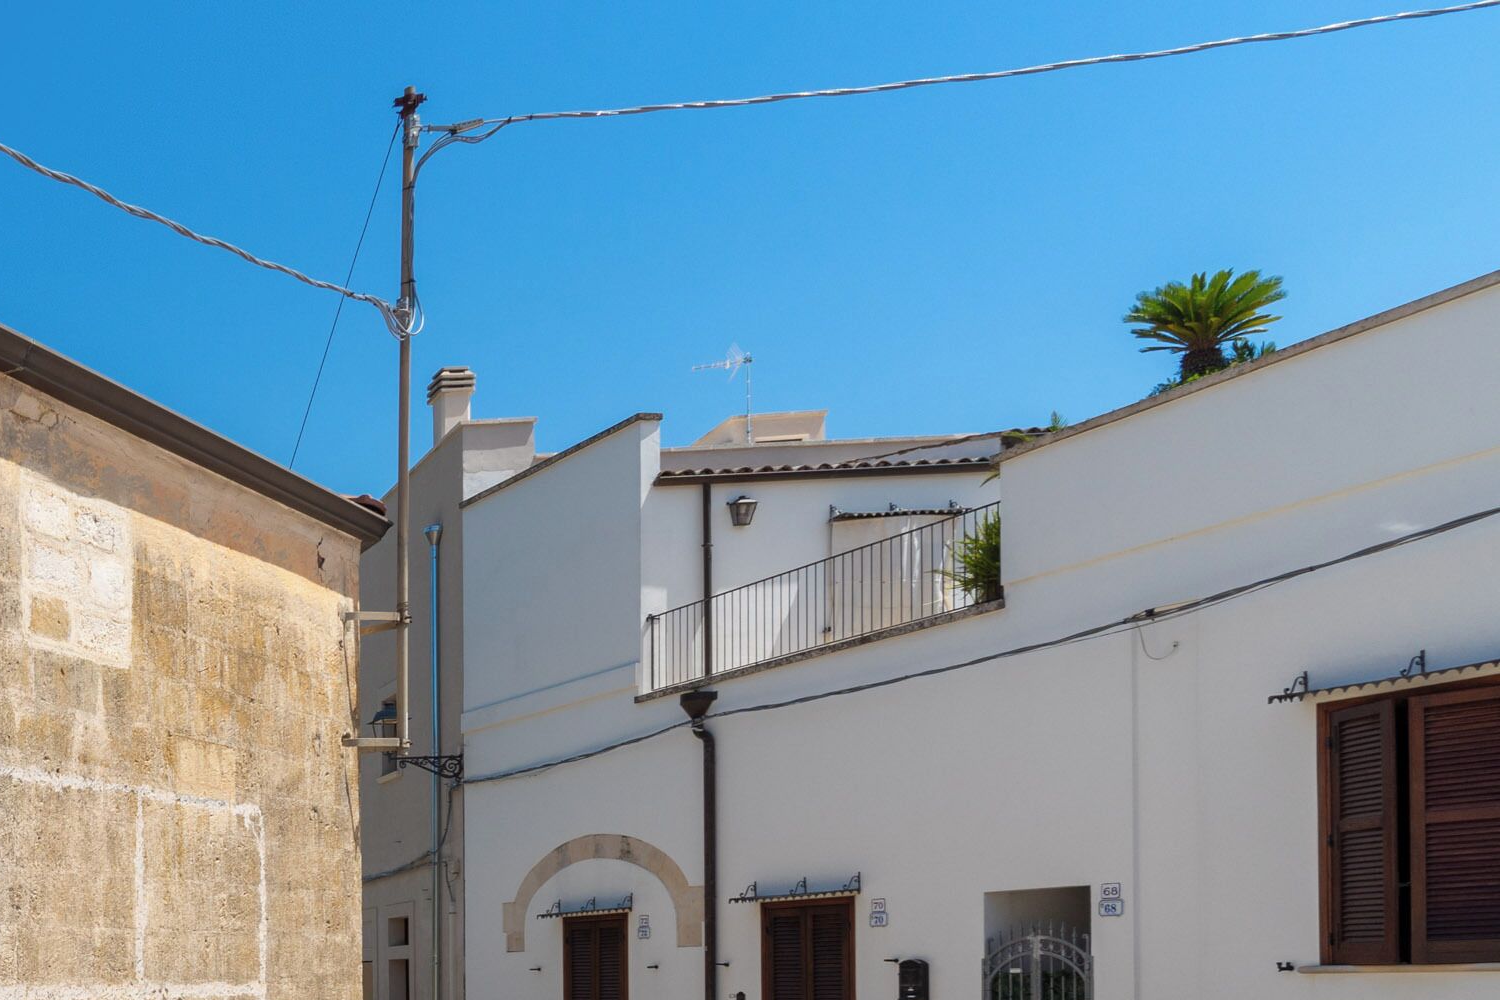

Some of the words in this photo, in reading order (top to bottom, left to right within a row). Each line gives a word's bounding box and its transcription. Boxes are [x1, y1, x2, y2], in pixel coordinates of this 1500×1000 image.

[1103, 887, 1118, 896] 68
[873, 902, 884, 910] 70
[1104, 903, 1117, 913] 68
[874, 916, 884, 925] 70
